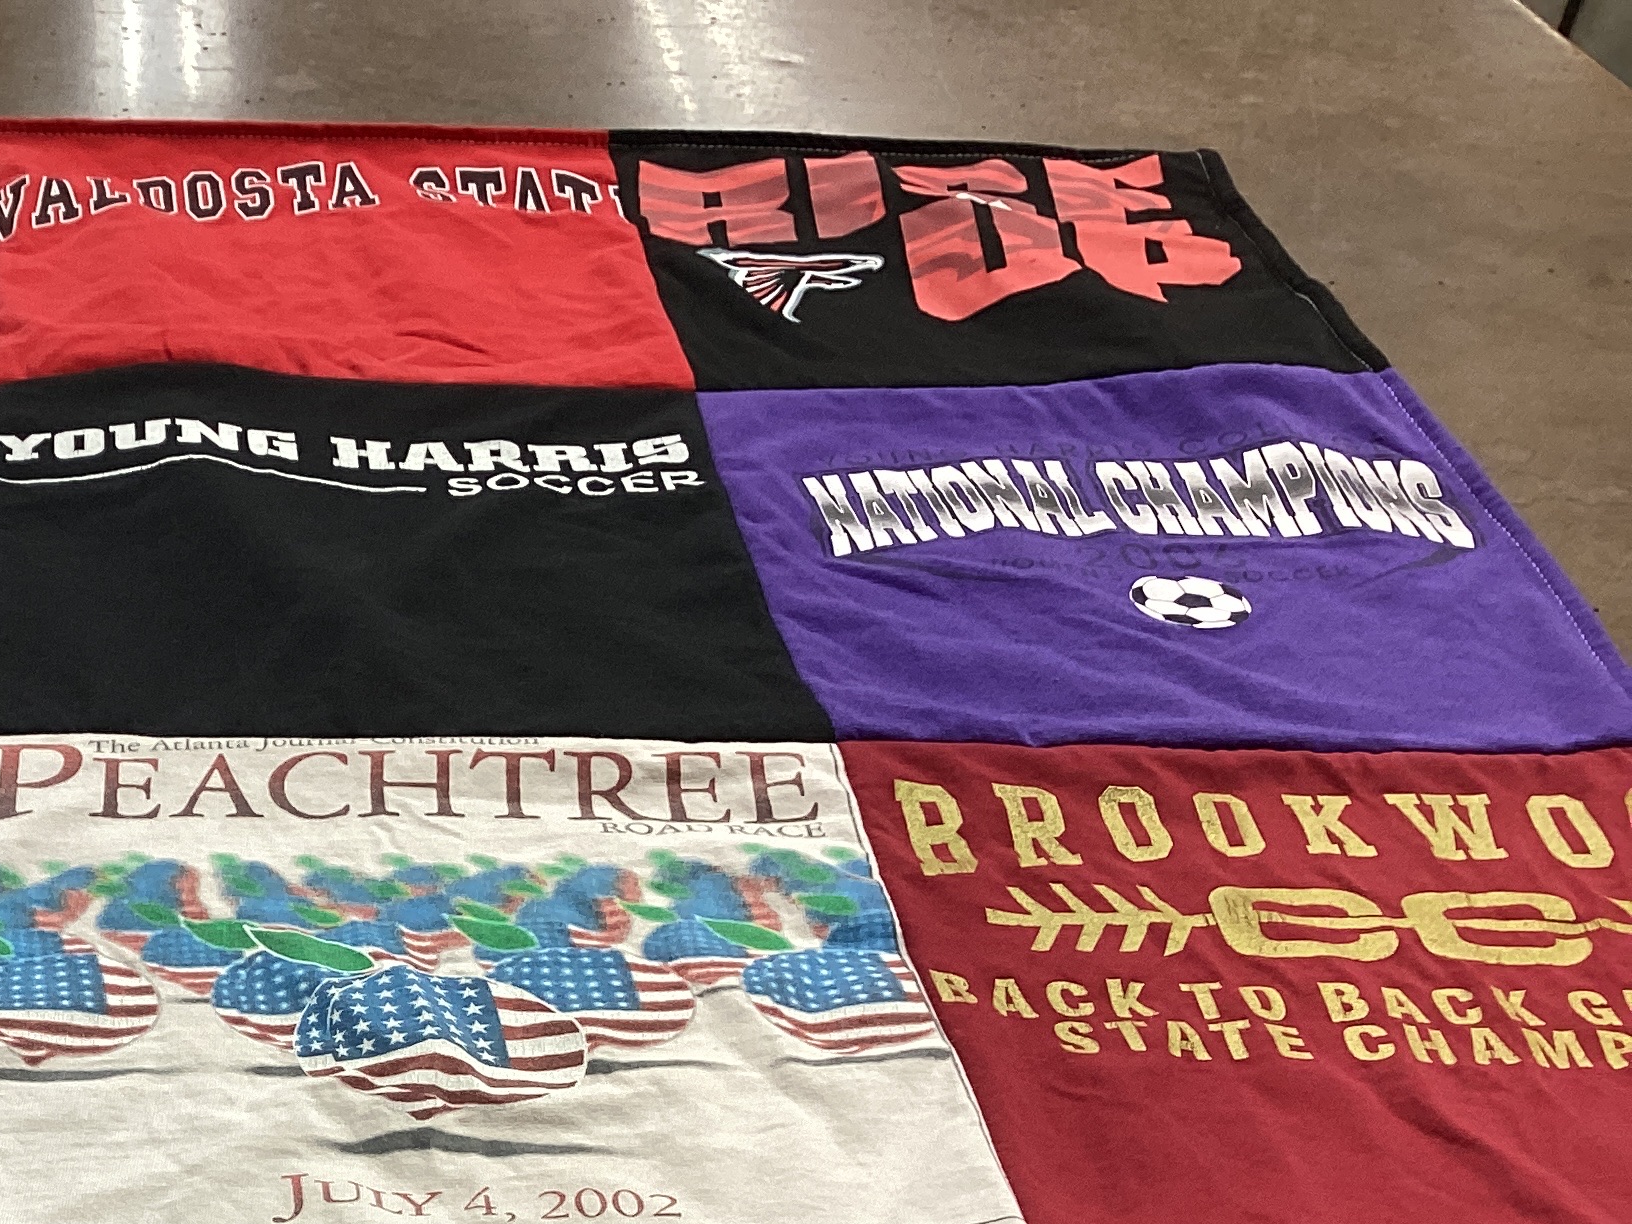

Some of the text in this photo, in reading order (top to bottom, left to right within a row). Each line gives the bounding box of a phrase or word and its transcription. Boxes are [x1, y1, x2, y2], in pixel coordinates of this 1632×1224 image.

[409, 167, 630, 222] STAT
[329, 433, 692, 473] HARRIS
[447, 470, 707, 498] SOCCER
[801, 440, 1476, 558] NATIONAL CHAMPIONS
[88, 739, 141, 754] The
[151, 738, 249, 752] Atlanta
[600, 821, 827, 839] ROAD RACE
[893, 779, 1632, 876] BROOKWO
[929, 970, 1632, 1027] BACK TO BACK G
[1054, 1020, 1632, 1071] STATE CHAMP
[271, 1172, 683, 1224] JULY 4, 2002
